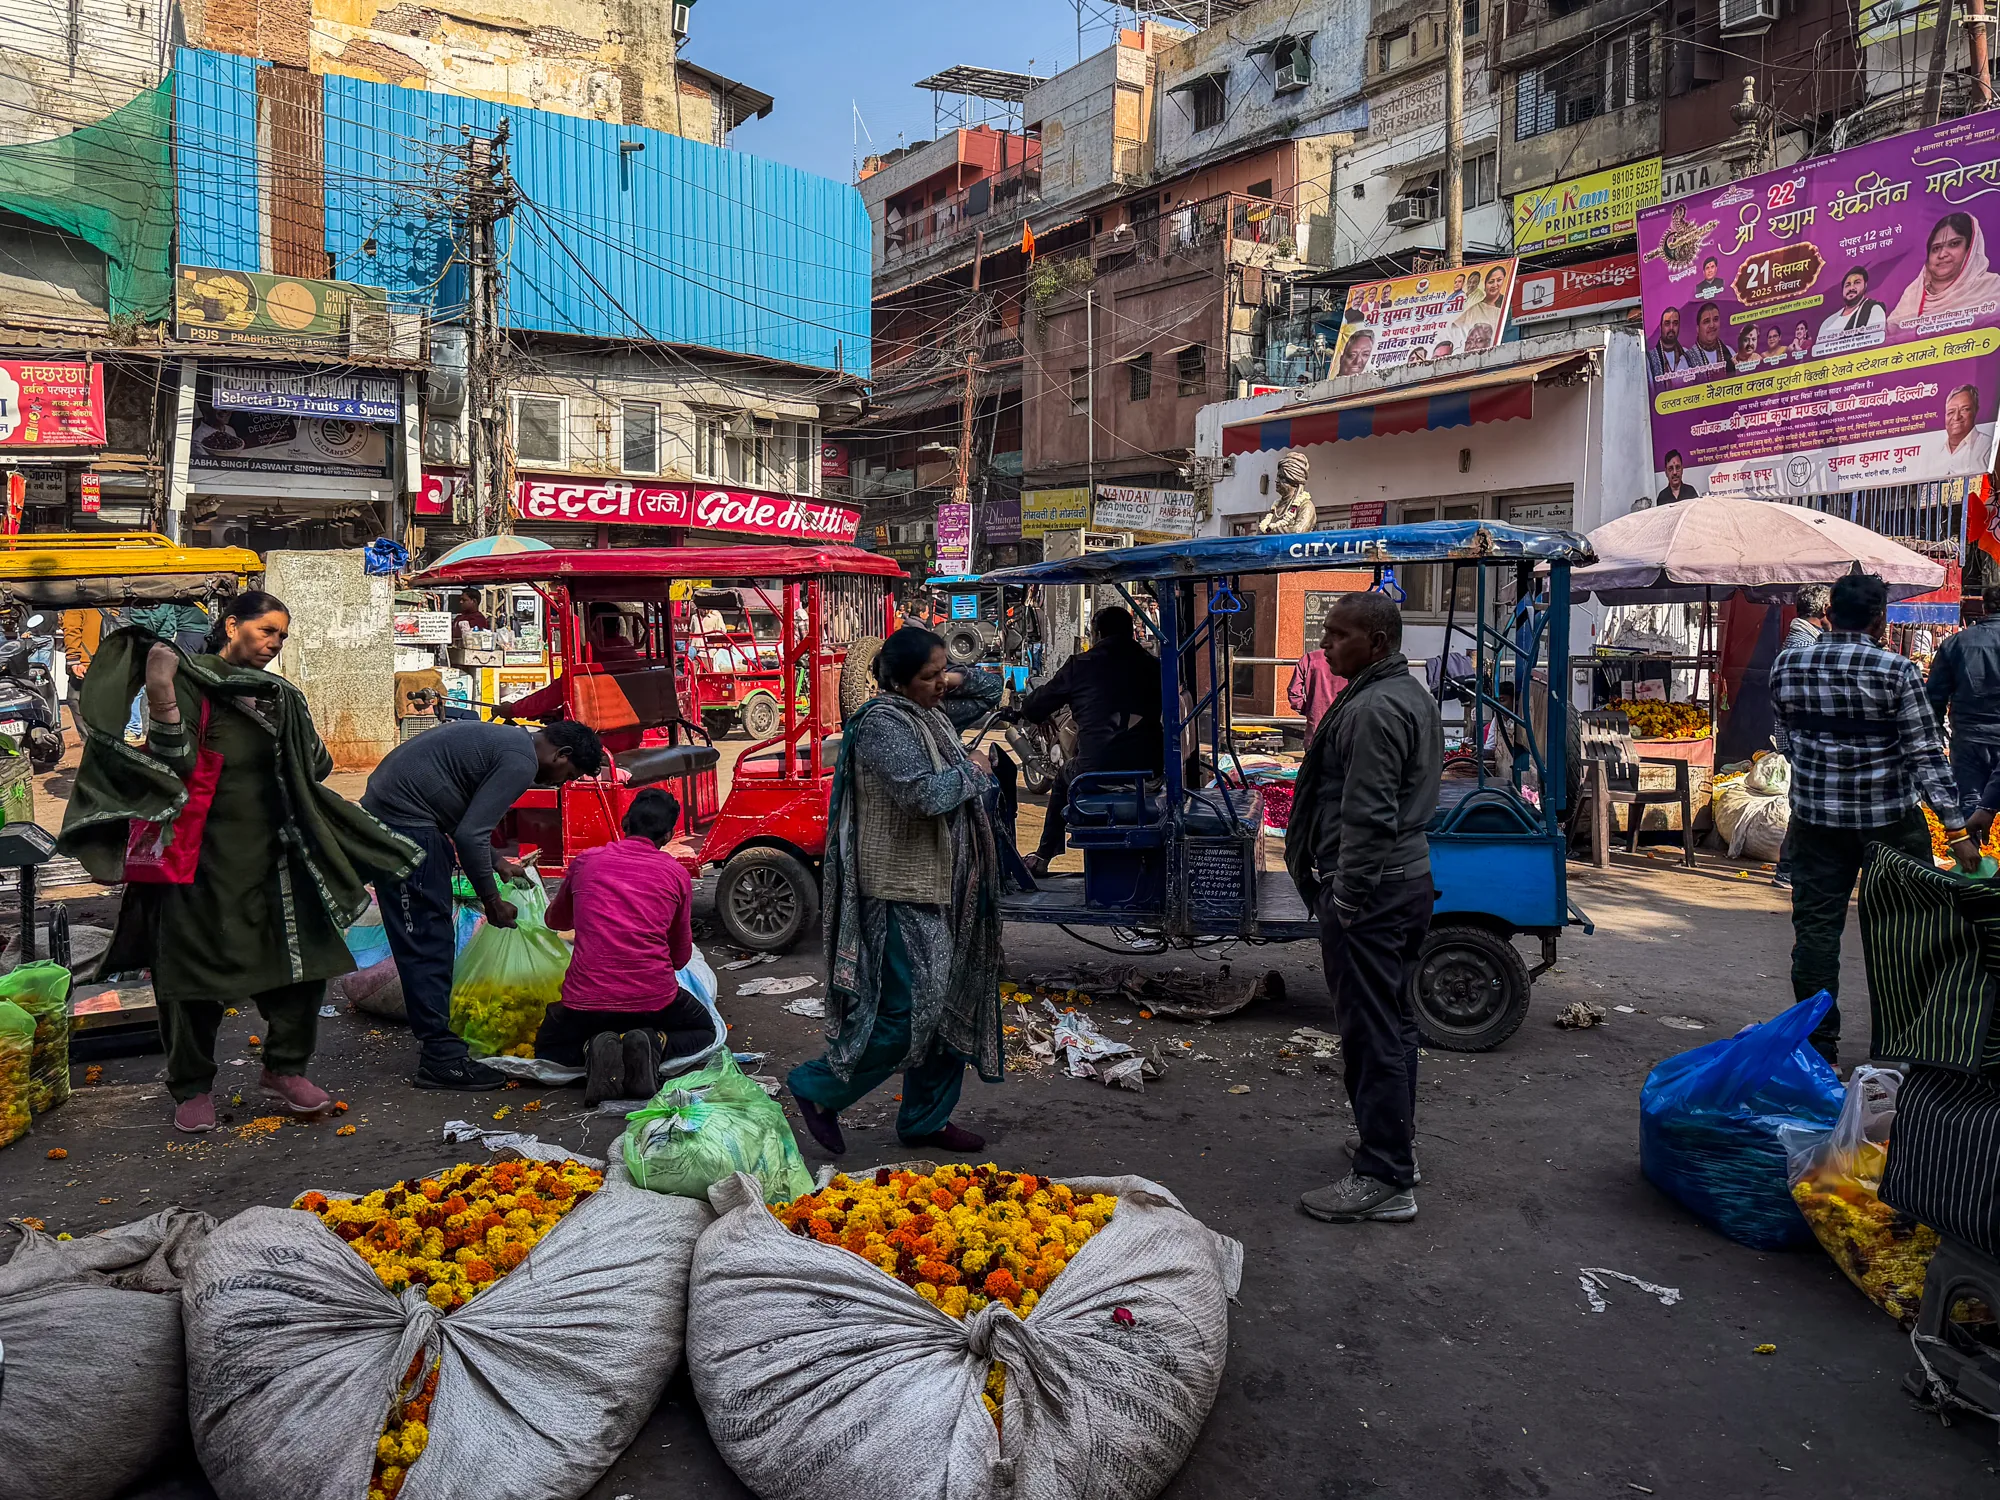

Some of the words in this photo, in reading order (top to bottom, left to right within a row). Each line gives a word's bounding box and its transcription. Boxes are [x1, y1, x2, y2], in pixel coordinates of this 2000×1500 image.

[1913, 145, 1921, 154] श्री
[1945, 136, 1963, 147] हनुमान
[1964, 132, 1973, 140] जी
[1974, 128, 1996, 138] महाराज
[1612, 168, 1635, 186] 98105
[1636, 162, 1659, 180] 62577
[1612, 185, 1635, 202] 98107
[1636, 179, 1658, 196] 52577
[1518, 194, 1558, 227] Shri
[1562, 184, 1610, 214] Ram
[1612, 201, 1634, 218] 92121
[1718, 203, 1761, 255] श्री
[1768, 206, 1818, 240] श्याम
[1828, 171, 1912, 221] संकीर्तन
[1911, 157, 2000, 205] महोत्स
[1545, 206, 1610, 233] PRINTERS
[1839, 235, 1861, 248] दोपहर
[1863, 230, 1876, 241] 12
[1878, 227, 1892, 238] बजे
[1894, 224, 1902, 234] से
[1846, 248, 1857, 257] प्रभु
[1859, 243, 1877, 255] इच्छा
[1879, 238, 1893, 248] तक
[1562, 263, 1636, 290] Prestige
[1746, 260, 1770, 289] 21
[1772, 258, 1811, 279] दिसम्बर
[1751, 287, 1772, 299] 2025
[1774, 279, 1801, 293] रविवार
[1364, 311, 1381, 327] श्री
[1383, 307, 1412, 326] सुमन
[1414, 302, 1444, 321] गुप्ता
[1446, 295, 1467, 312] जी
[1900, 315, 1930, 328] आदरणीय
[1964, 306, 1979, 318] पूनम
[1980, 302, 1996, 313] दीदी
[190, 327, 219, 340] PSJS
[231, 333, 270, 344] PRABHA
[1382, 328, 1391, 337] को
[1422, 322, 1436, 332] जाने
[1377, 337, 1408, 351] हार्दिक
[1370, 355, 1376, 365] व
[221, 366, 267, 393] PRABHA
[269, 372, 305, 396] SINGH
[308, 375, 358, 401] JASWANT
[361, 379, 396, 404] SINGH
[1661, 399, 1681, 410] उत्सव
[1683, 394, 1700, 407] स्थल
[1707, 382, 1743, 401] नैशनल
[1746, 376, 1775, 392] क्लब
[1777, 372, 1802, 390] पुरानी
[1803, 367, 1830, 382] दिल्ली
[1832, 361, 1854, 377] रेलवे
[1856, 357, 1888, 373] स्टेशन
[1891, 352, 1904, 366] के
[1906, 346, 1939, 363] सामने,
[22, 383, 44, 394] हर्बल
[47, 386, 77, 398] परफ्यूम
[1738, 403, 1747, 411] आप
[1748, 401, 1759, 410] सभी
[1829, 388, 1842, 396] सादर
[1843, 382, 1866, 393] आमंत्रित
[221, 392, 272, 406] Selected
[278, 397, 299, 411] Dry
[304, 398, 339, 412] Fruits
[345, 404, 354, 413] &
[360, 404, 395, 417] Spices
[1691, 421, 1722, 437] आयोजक
[1729, 411, 1743, 428] श्री
[1744, 412, 1768, 427] श्याम
[1770, 409, 1793, 427] कृपा
[1834, 392, 1856, 412] खारी
[248, 421, 290, 433] DELICIOUS
[190, 459, 219, 467] RABHA
[220, 460, 249, 469] SINGH
[251, 462, 293, 472] JASWANT
[294, 464, 321, 473] SINGH
[1827, 456, 1856, 472] सुमन
[1858, 450, 1889, 468] कुमार
[1893, 445, 1922, 463] गुप्ता
[83, 476, 98, 485] हवन
[1710, 471, 1730, 484] प्रवीण
[1732, 469, 1751, 482] शंकर
[1754, 468, 1773, 481] कपूर
[1837, 473, 1849, 482] निगम
[1892, 465, 1907, 475] दिल्ली
[529, 479, 636, 518] हट्टी
[637, 489, 687, 518] (रजि.)
[1103, 488, 1151, 504] NANDAN
[697, 492, 776, 527] Gole
[777, 501, 844, 534] Hatti
[985, 505, 1020, 525] Dhingra
[1023, 507, 1048, 520] मोमबत्ती
[1050, 506, 1057, 520] ही
[1059, 505, 1087, 519] मोमबत्ती
[1096, 500, 1133, 513] TRADING
[1135, 503, 1151, 514] CO.
[1526, 510, 1544, 518] HPL
[875, 526, 886, 537] R.B.
[1289, 542, 1338, 558] CITY
[1343, 539, 1388, 555] LIFE
[928, 560, 935, 568] R
